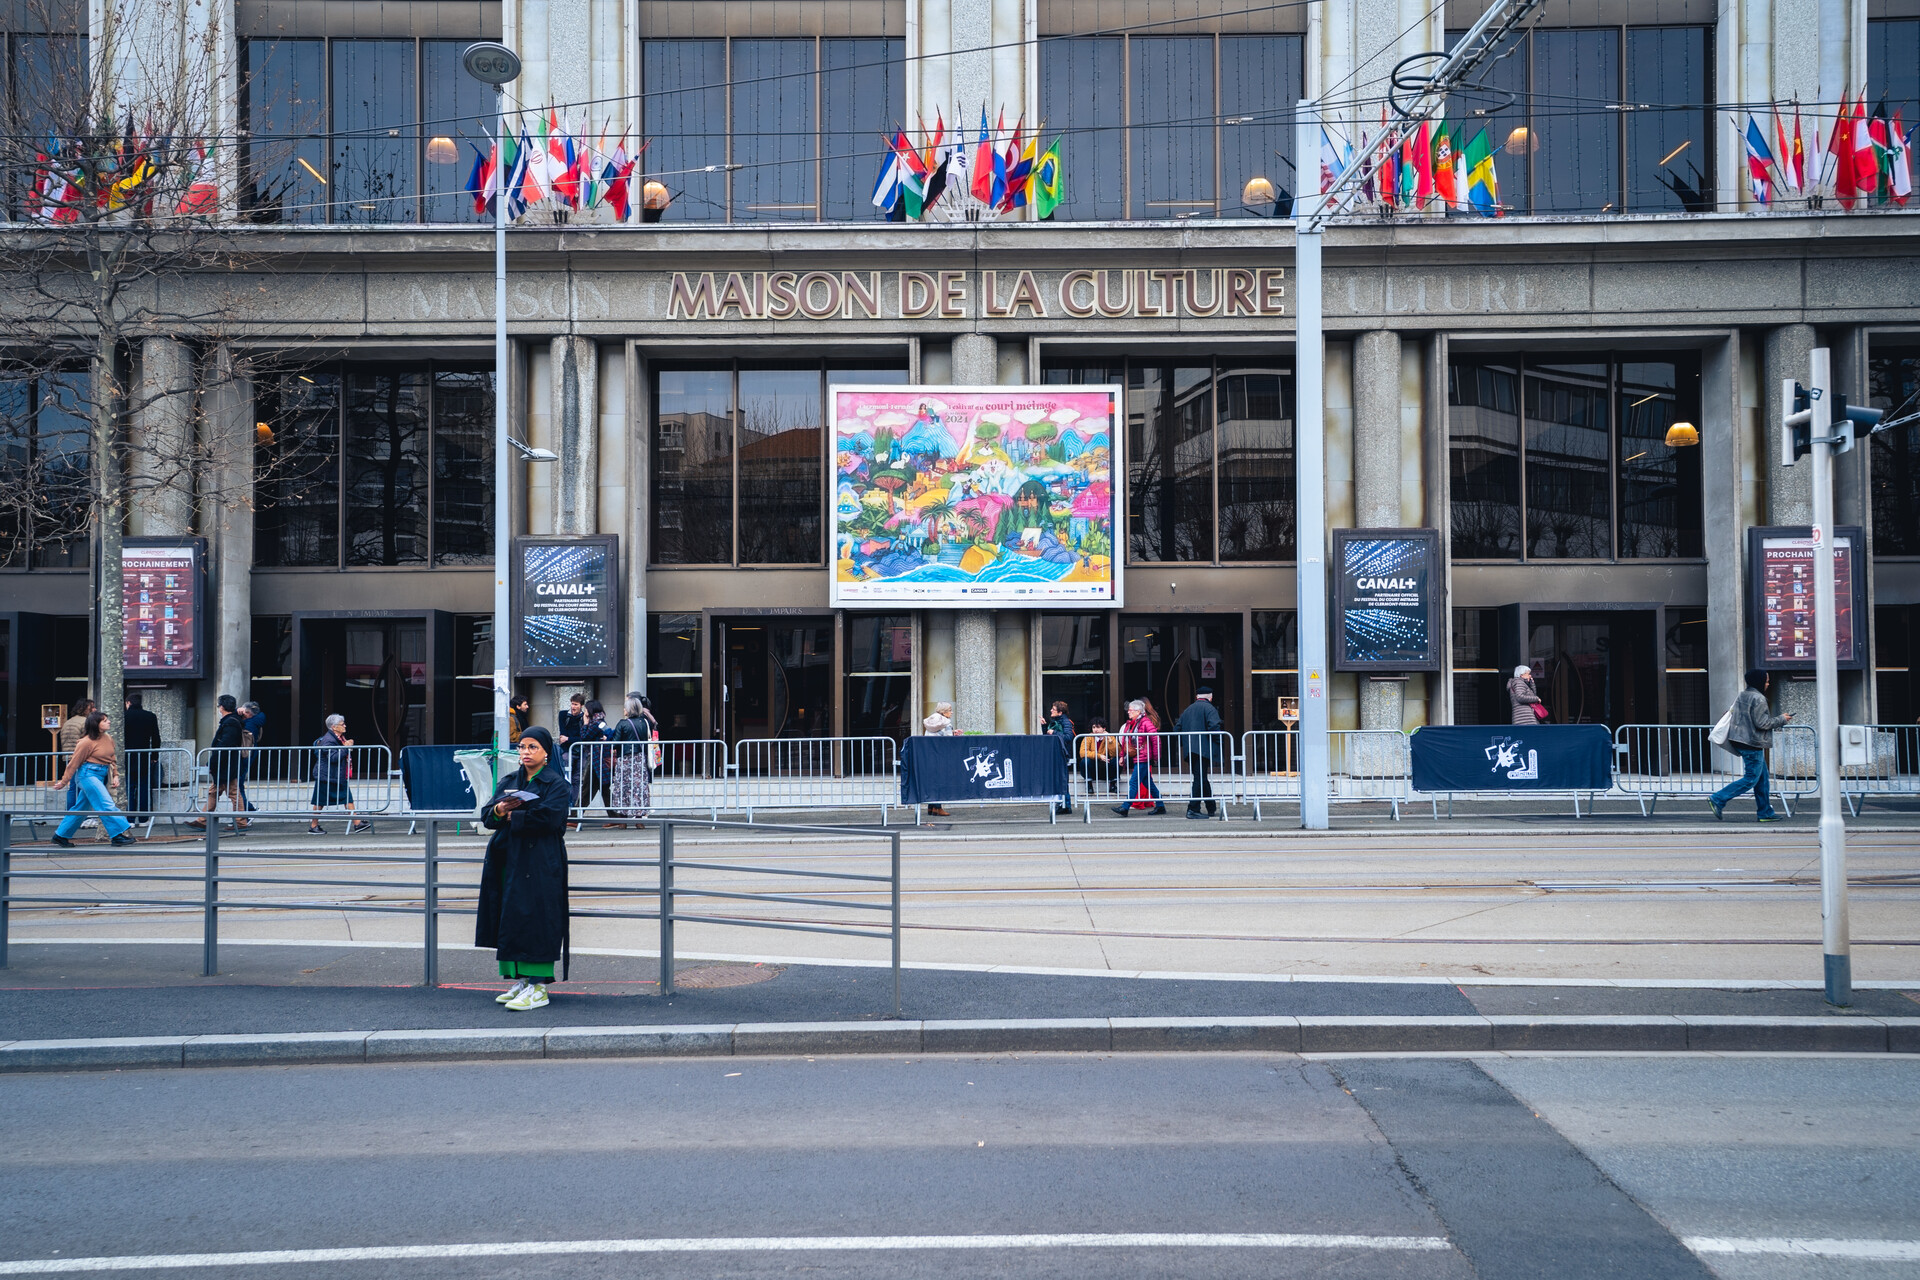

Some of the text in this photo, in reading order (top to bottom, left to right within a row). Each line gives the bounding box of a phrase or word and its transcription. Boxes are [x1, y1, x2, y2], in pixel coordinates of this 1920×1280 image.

[410, 281, 610, 318] MASON
[666, 271, 882, 319] MAISON
[899, 271, 966, 318] DE
[982, 270, 1048, 318] LA
[1058, 268, 1285, 317] CULTURE
[985, 400, 1014, 411] court
[1016, 400, 1057, 413] métrage
[536, 584, 596, 595] CANAL+
[1356, 578, 1416, 590] CANAL+
